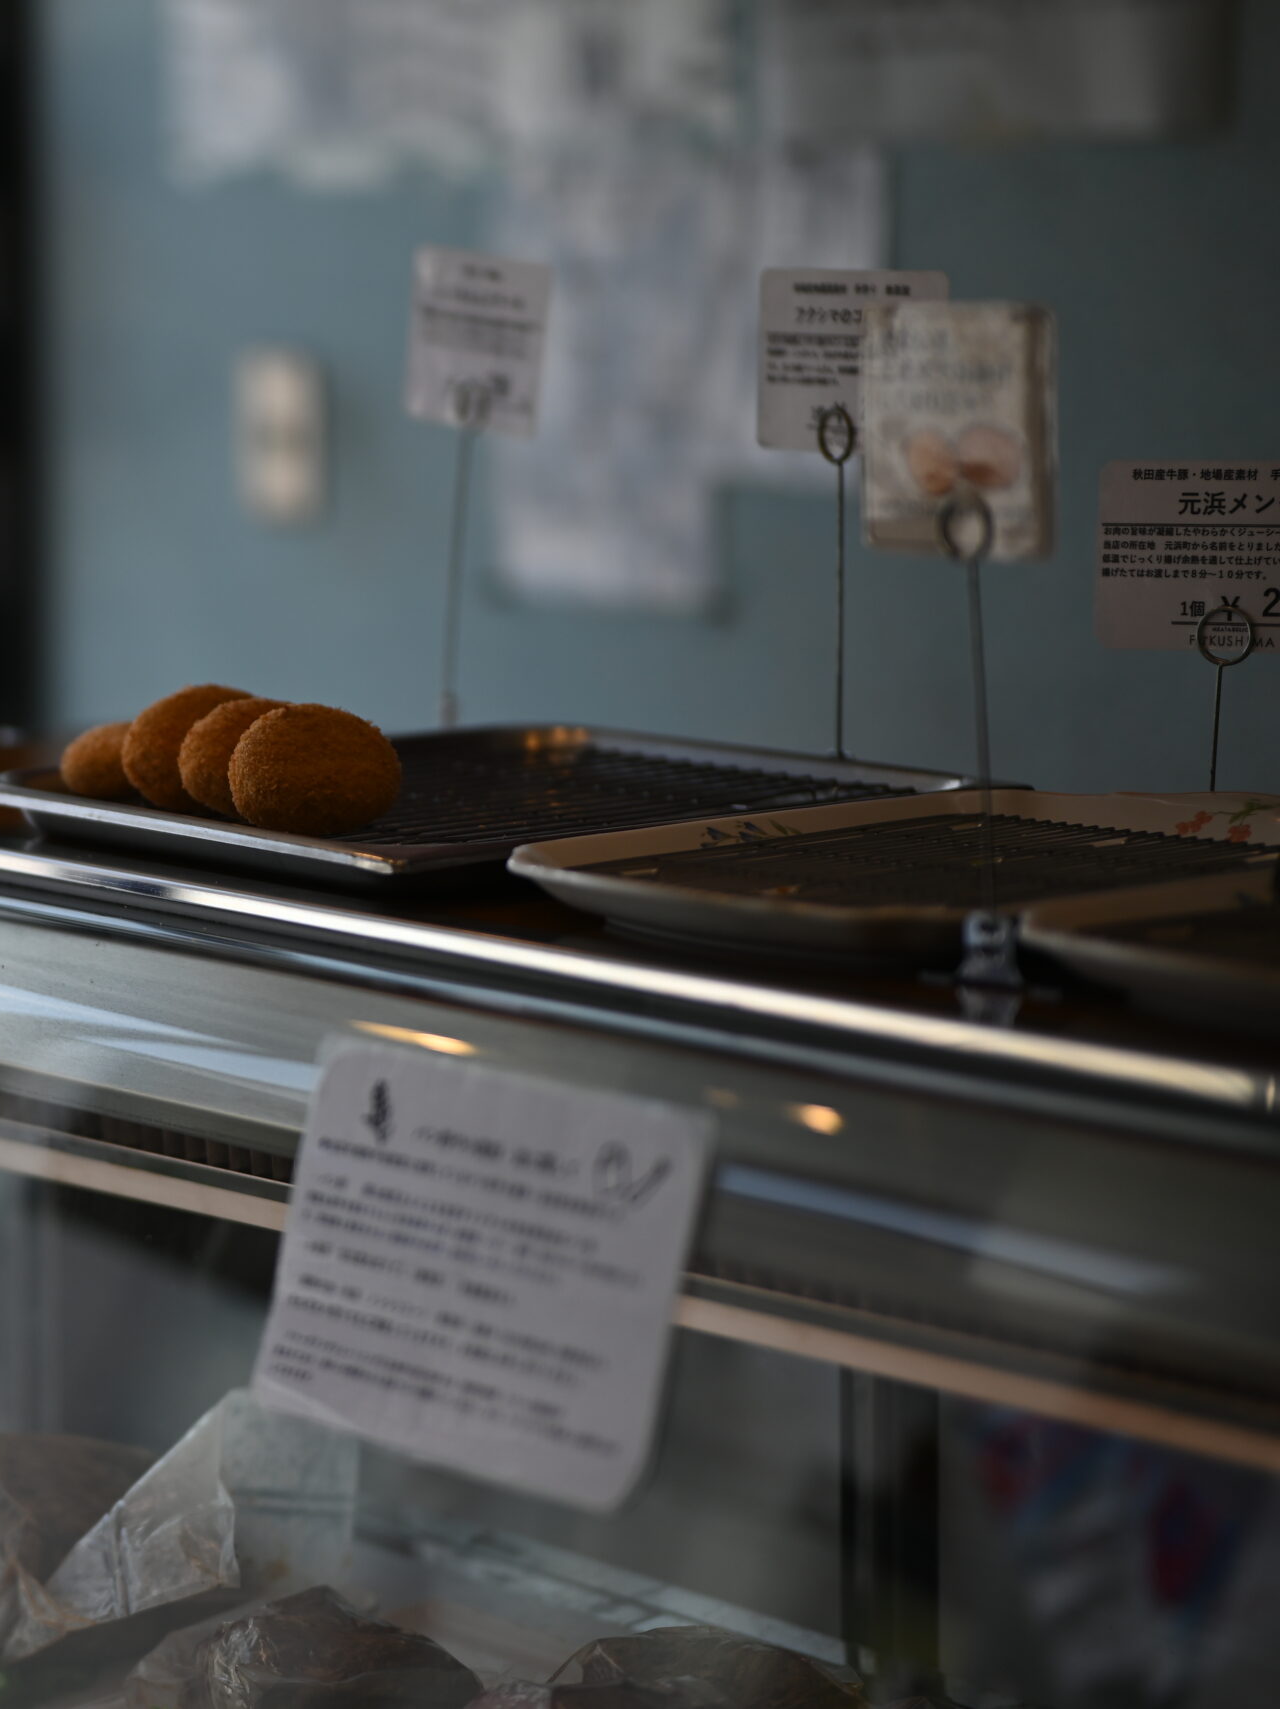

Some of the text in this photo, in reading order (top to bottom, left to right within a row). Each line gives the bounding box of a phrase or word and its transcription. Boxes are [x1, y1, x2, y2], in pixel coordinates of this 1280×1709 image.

[1178, 491, 1276, 515] 元浜メン
[1180, 600, 1205, 617] 1個
[1189, 634, 1275, 649] FKUSHMA
